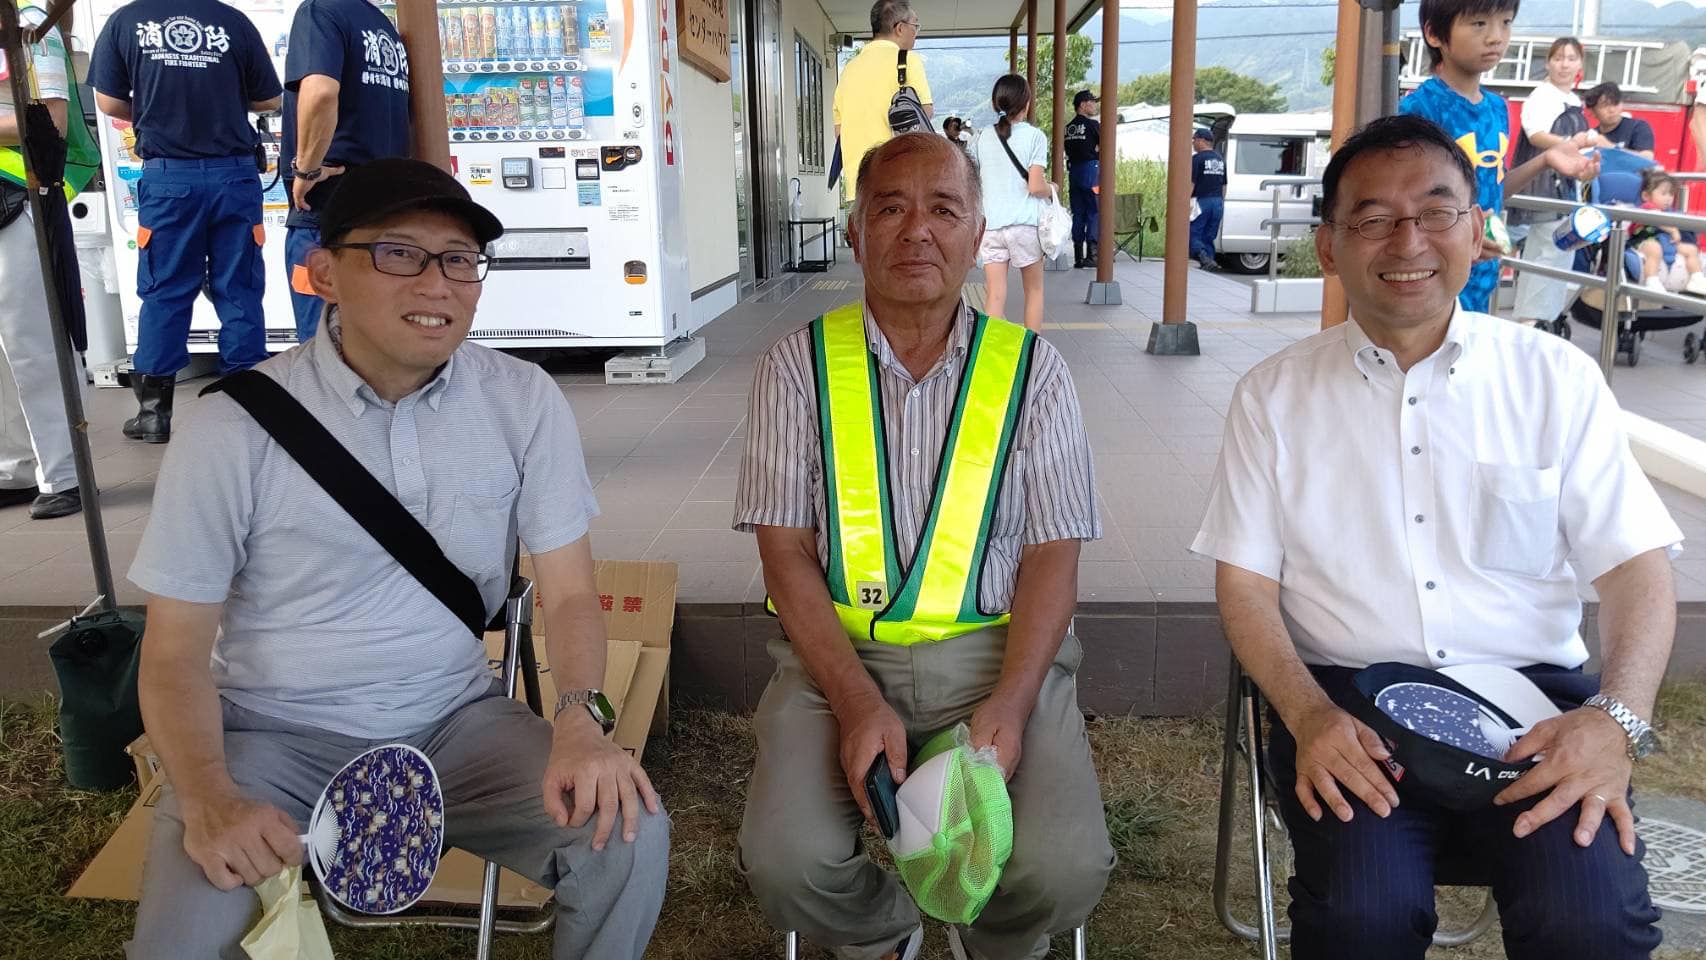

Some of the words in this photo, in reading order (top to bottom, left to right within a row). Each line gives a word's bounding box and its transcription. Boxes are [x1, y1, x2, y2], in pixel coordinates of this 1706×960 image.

[688, 7, 728, 56] センターハウス
[861, 587, 882, 604] 32
[1464, 761, 1491, 781] V1
